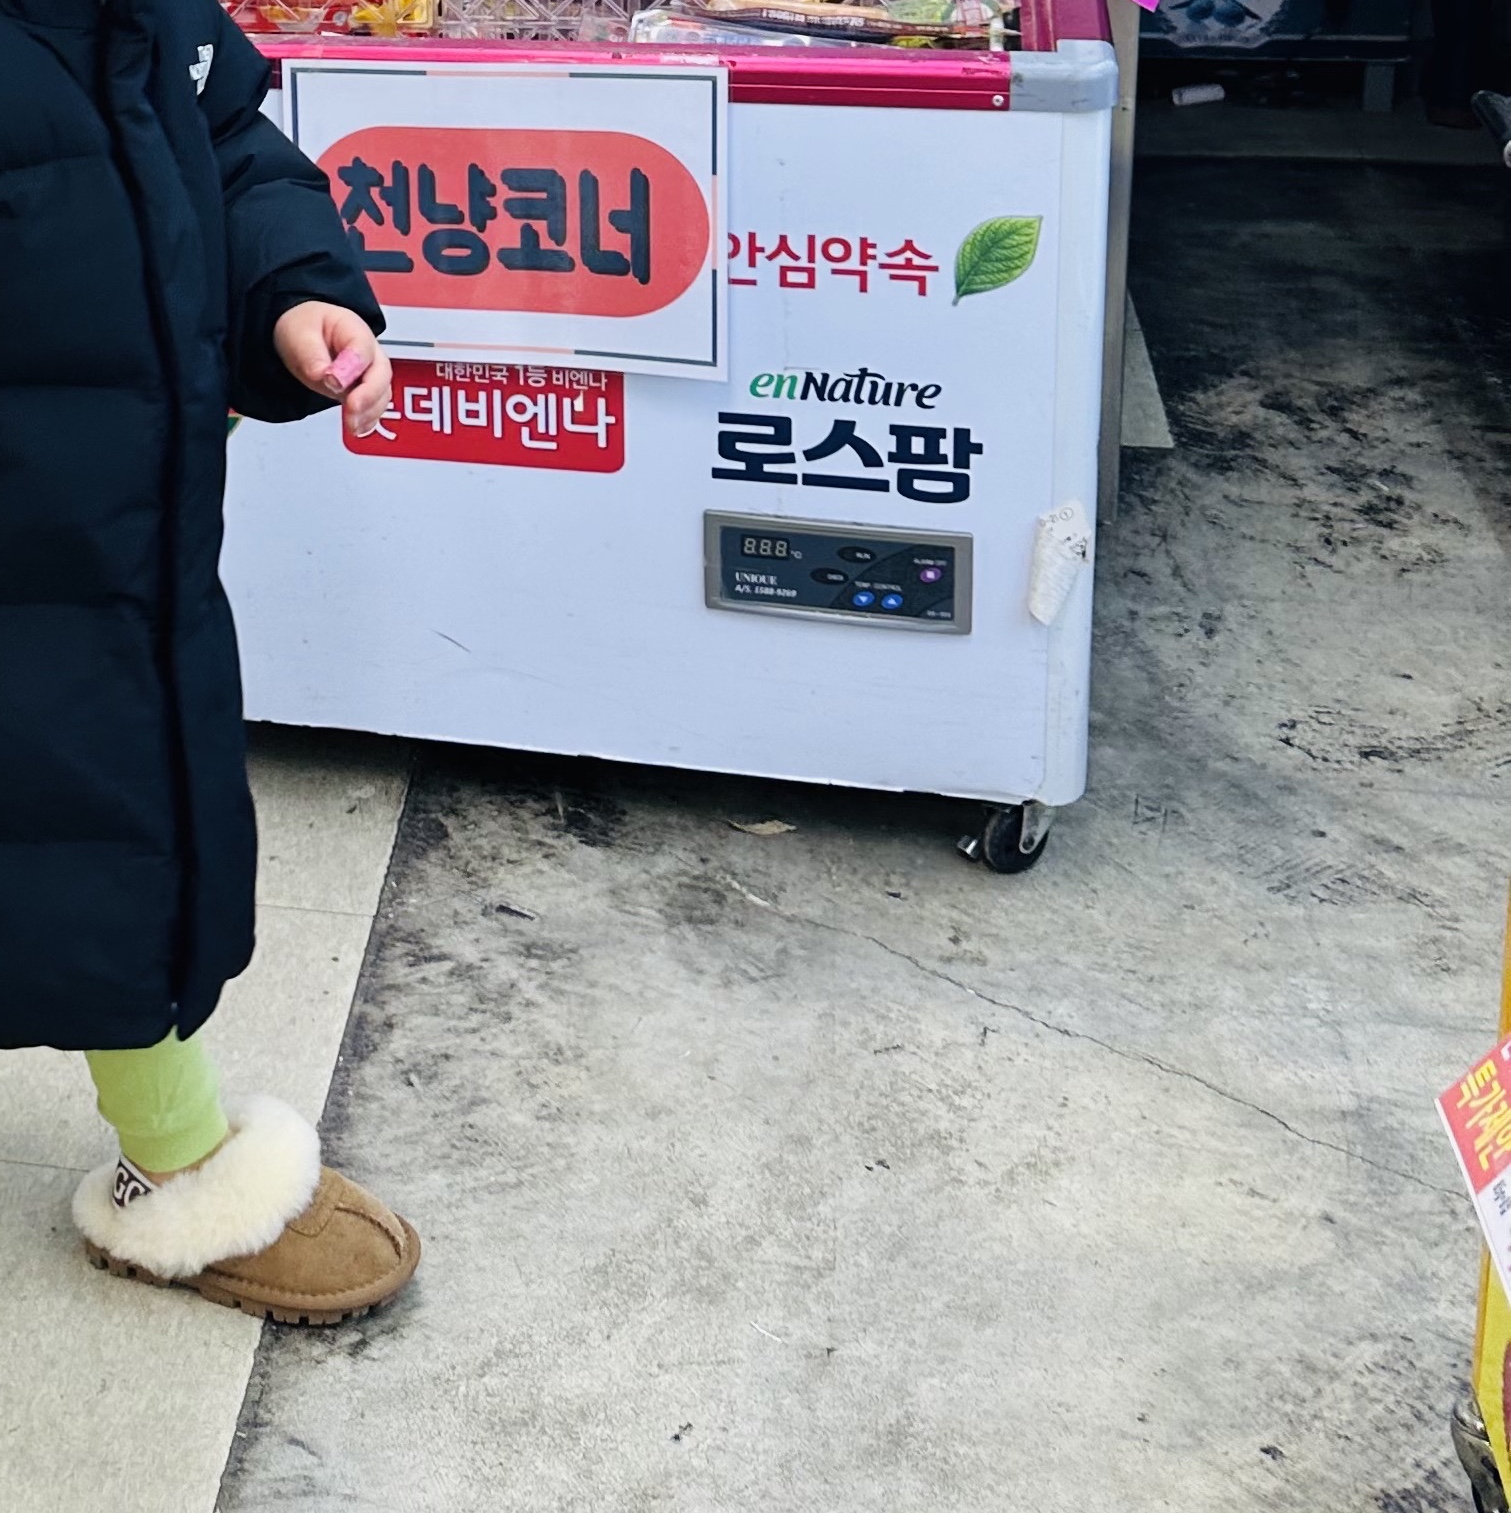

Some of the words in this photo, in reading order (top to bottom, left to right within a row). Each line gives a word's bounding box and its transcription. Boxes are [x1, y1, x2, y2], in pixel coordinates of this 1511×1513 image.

[336, 156, 651, 285] 천냥코너
[728, 232, 939, 297] 안심약속
[436, 362, 509, 385] 대한민국
[514, 365, 548, 388] 1등
[552, 369, 608, 392] 비엔나
[749, 367, 942, 410] enNature
[734, 571, 779, 587] UNIQUE
